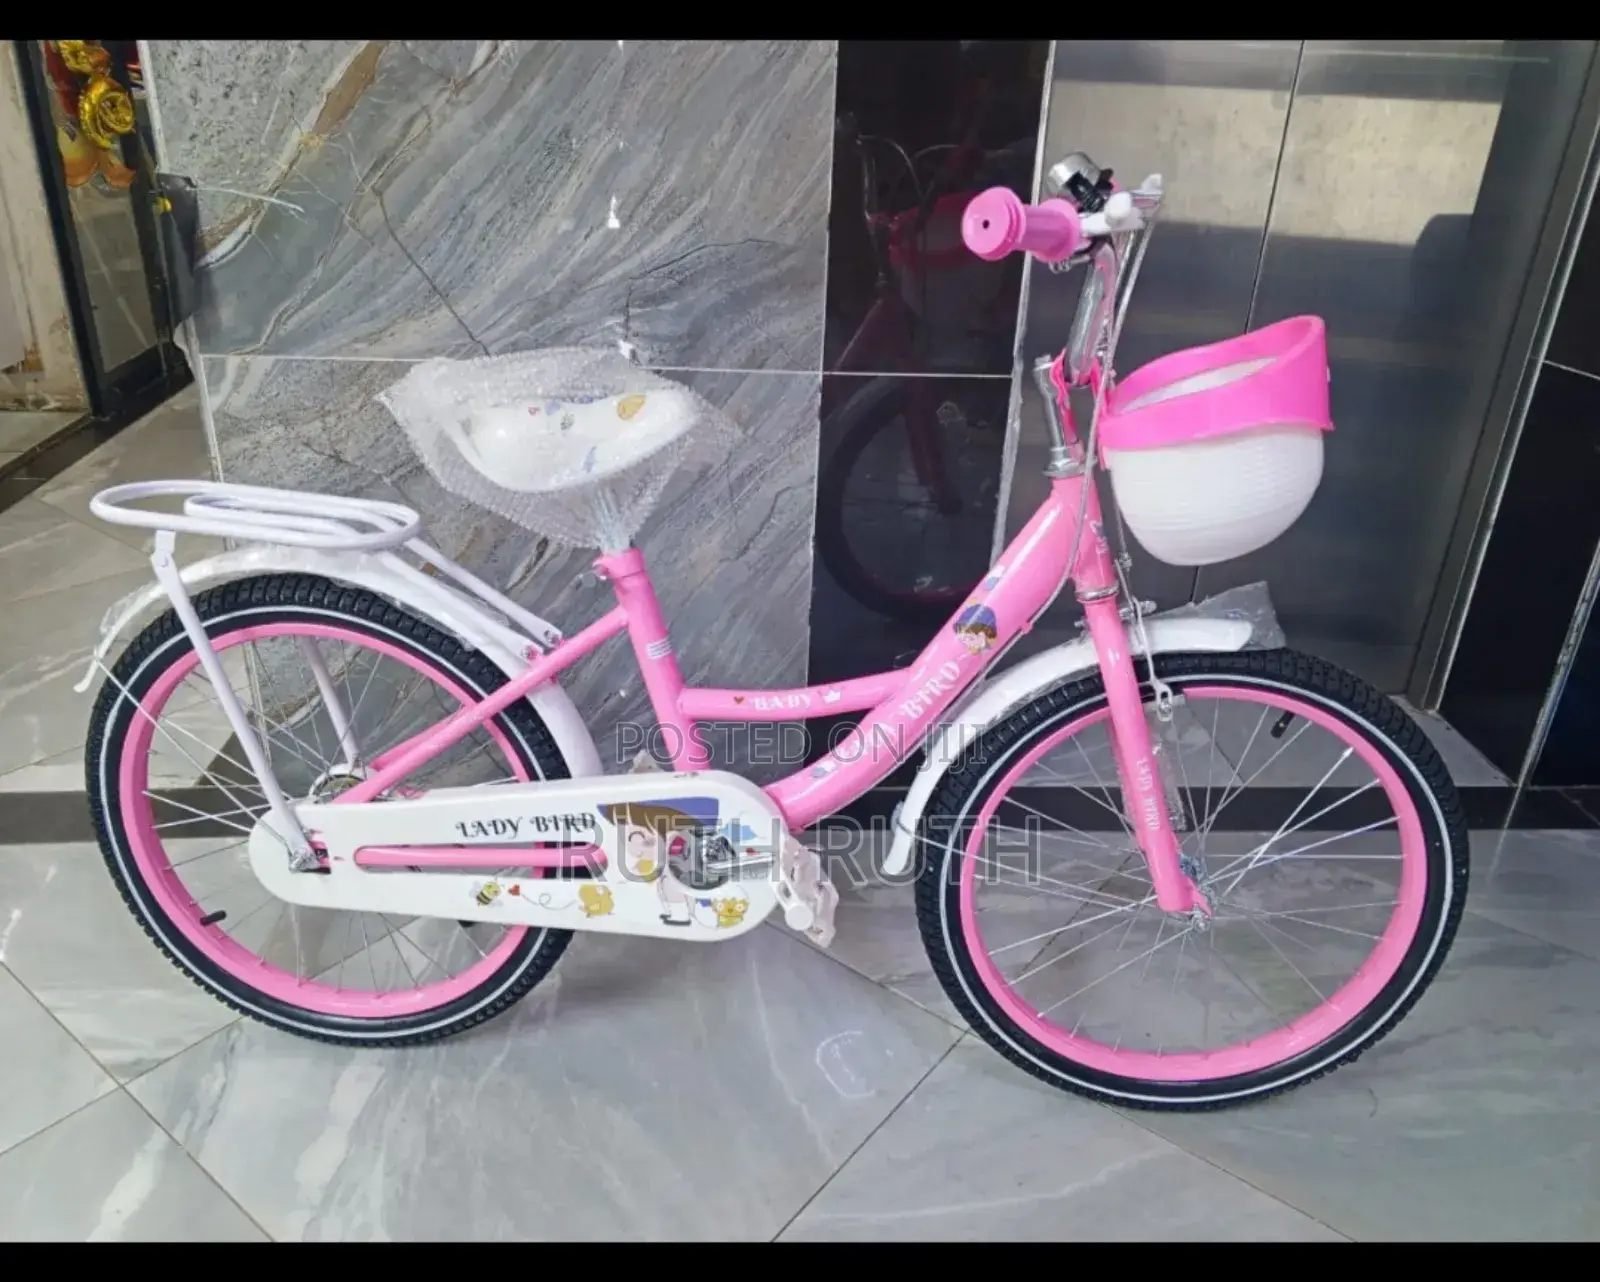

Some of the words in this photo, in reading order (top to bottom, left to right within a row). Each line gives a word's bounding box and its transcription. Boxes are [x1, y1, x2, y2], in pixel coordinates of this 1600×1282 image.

[898, 661, 960, 718] BIRD
[455, 816, 524, 839] LADY
[530, 812, 596, 833] BIRD
